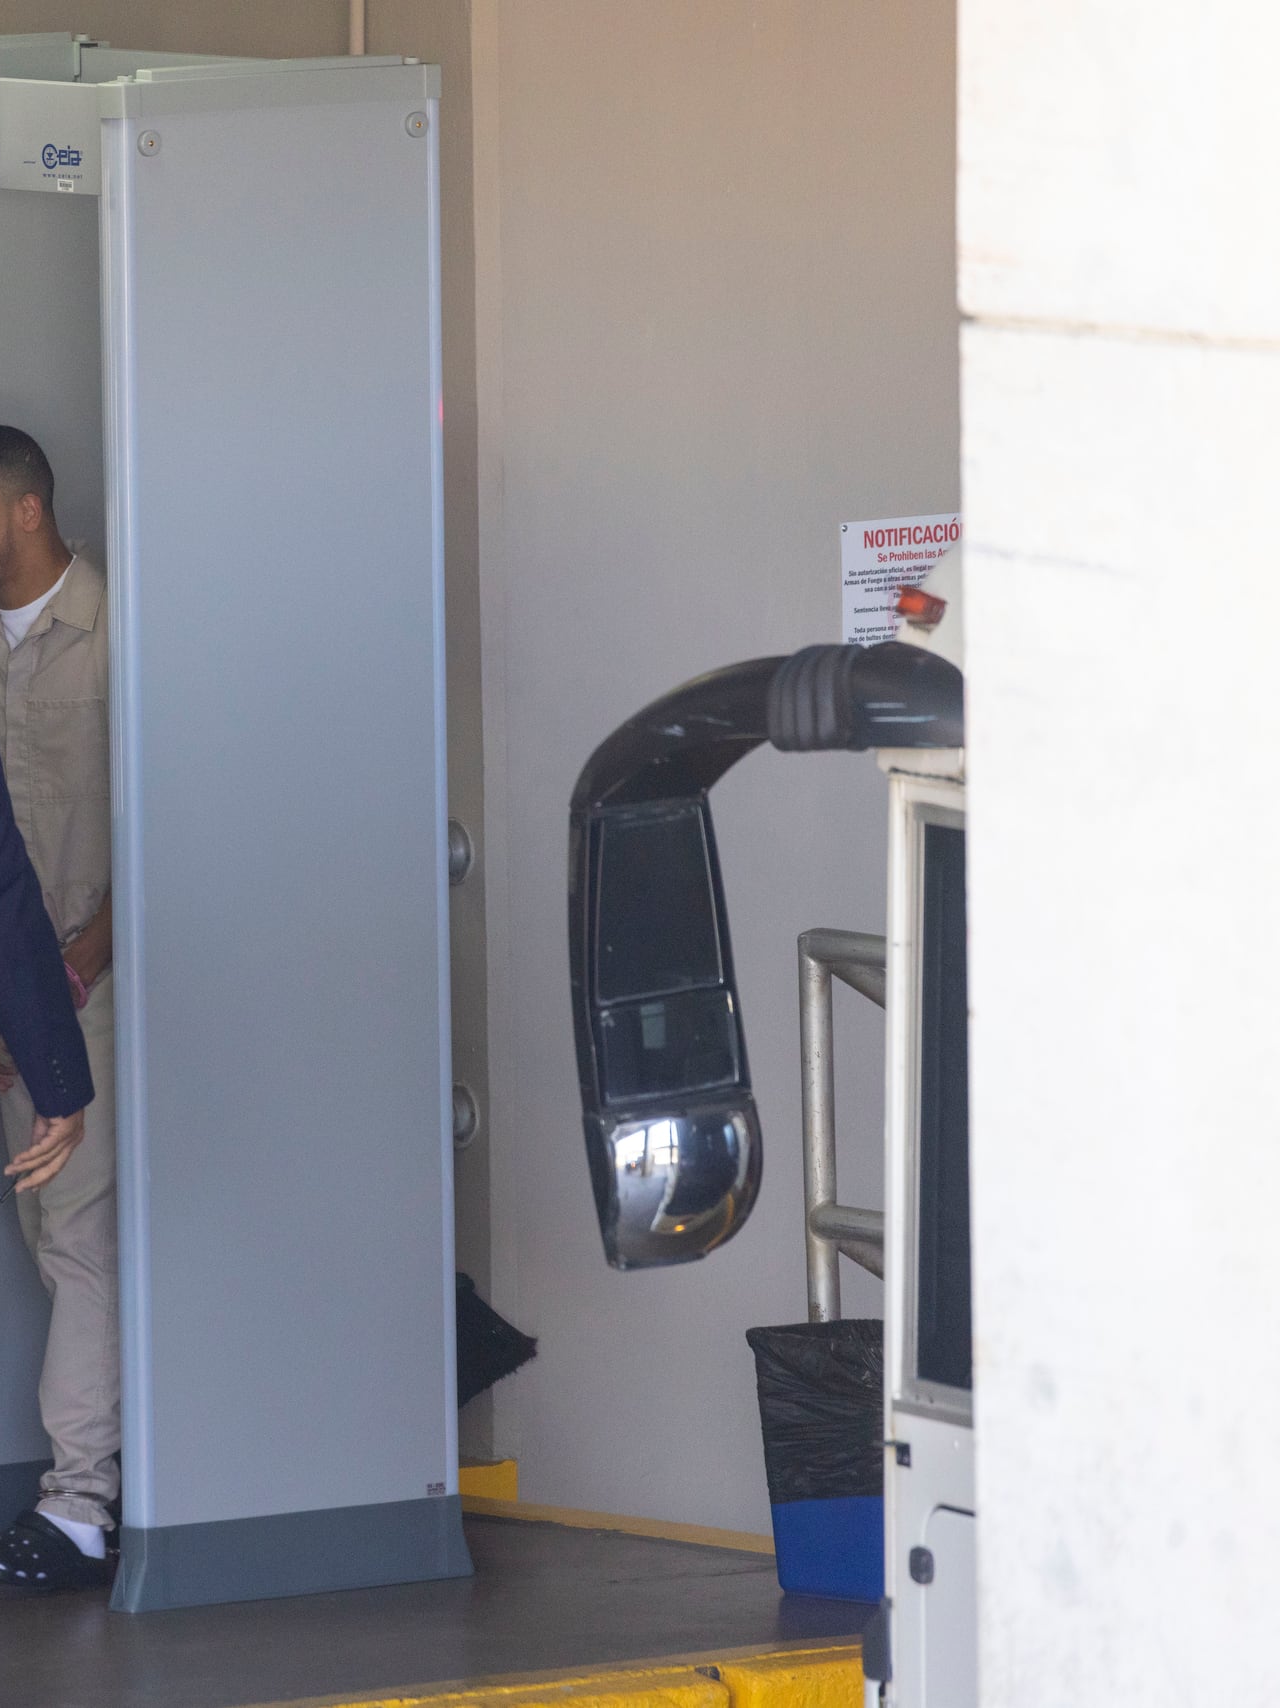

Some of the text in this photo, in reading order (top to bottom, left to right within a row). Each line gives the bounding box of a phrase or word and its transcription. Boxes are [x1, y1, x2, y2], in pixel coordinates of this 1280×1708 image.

[863, 517, 960, 549] NOTIFICACIÓ
[877, 553, 888, 563] Se
[889, 550, 923, 561] Prohiben
[925, 549, 936, 559] las
